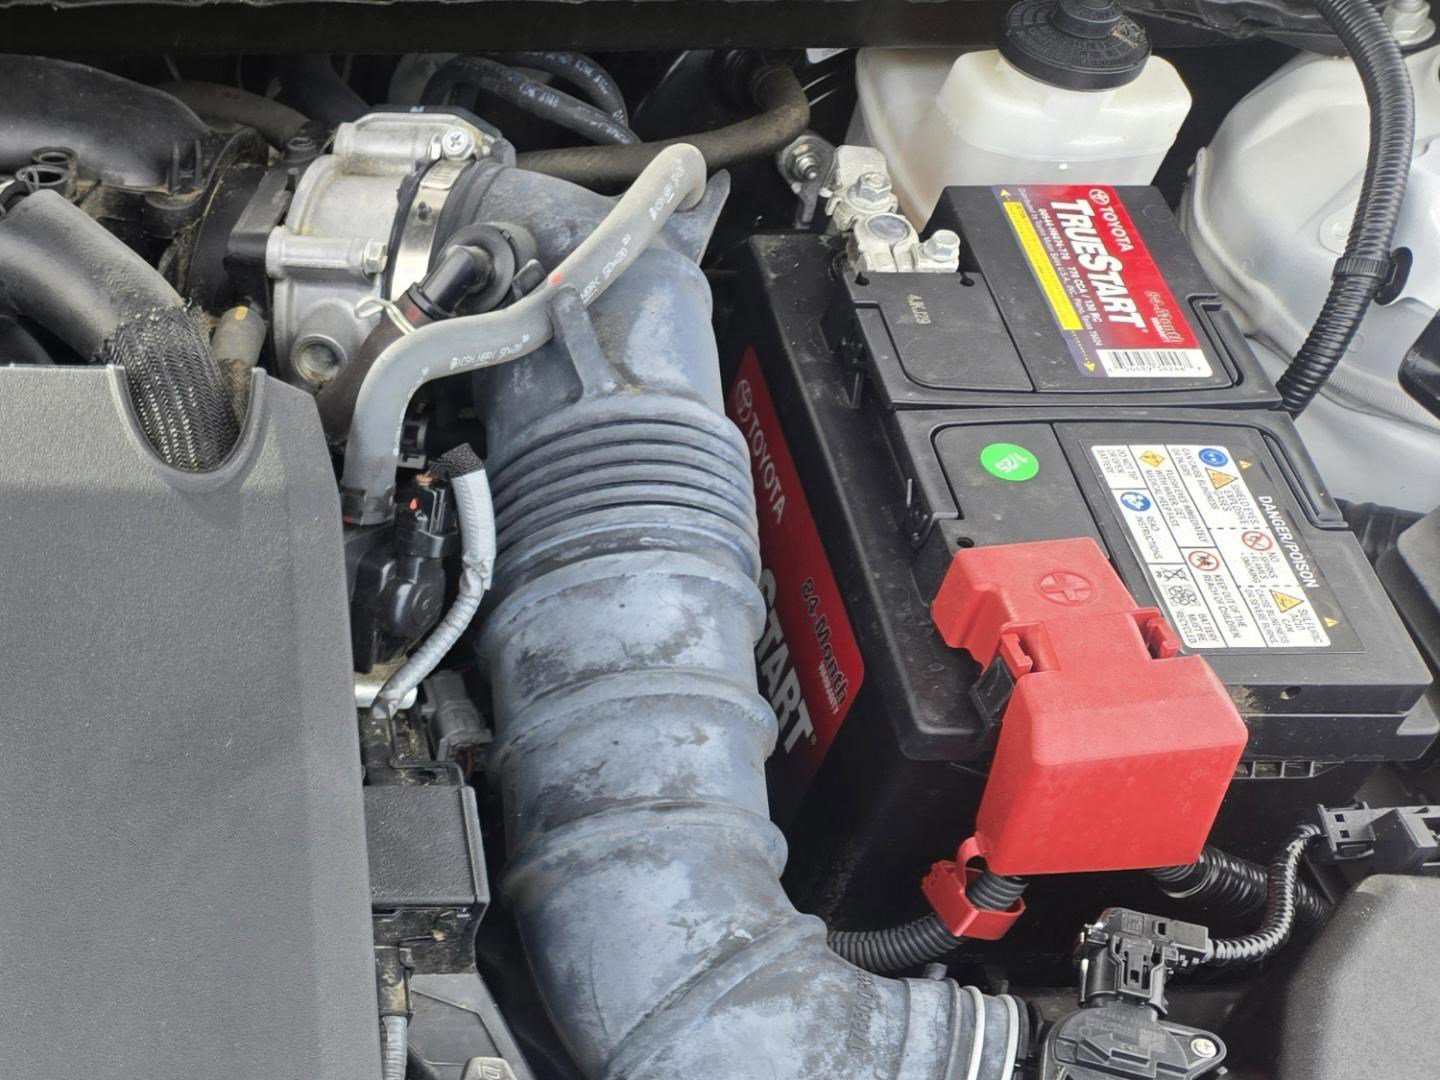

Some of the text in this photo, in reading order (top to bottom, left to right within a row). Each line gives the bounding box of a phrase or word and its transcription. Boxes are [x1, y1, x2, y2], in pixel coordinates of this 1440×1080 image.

[1101, 207, 1135, 252] TOYOTA
[1072, 279, 1088, 292] CCA
[1088, 312, 1103, 322] RC
[747, 420, 786, 525] TOYOTA
[1153, 470, 1169, 485] WITH
[1180, 448, 1220, 509] CAN CAUSE BLINDNESS
[1143, 470, 1164, 495] MEDICAL
[1157, 496, 1172, 511] HELP
[1163, 470, 1209, 543] FLUSH EYES IMMEDIATELY
[1213, 491, 1232, 511] GASES
[1145, 516, 1161, 531] READ
[1223, 491, 1250, 524] EXPLOSIVE
[1256, 496, 1318, 586] DANGER/POISON
[1249, 556, 1269, 579] FLAMES
[1202, 575, 1221, 595] REACH
[1213, 597, 1225, 605] OF
[1212, 574, 1229, 590] KEEP
[1221, 591, 1235, 603] OUT
[1233, 615, 1247, 627] THE
[1186, 614, 1203, 631] MUST
[1248, 599, 1268, 620] SEVERE
[1254, 589, 1290, 643] CAUSE BLINDNESS
[1280, 618, 1295, 631] CAN
[1289, 614, 1305, 630] ACID
[1297, 609, 1323, 642] SULFURIC
[1197, 613, 1219, 641] BATTERY
